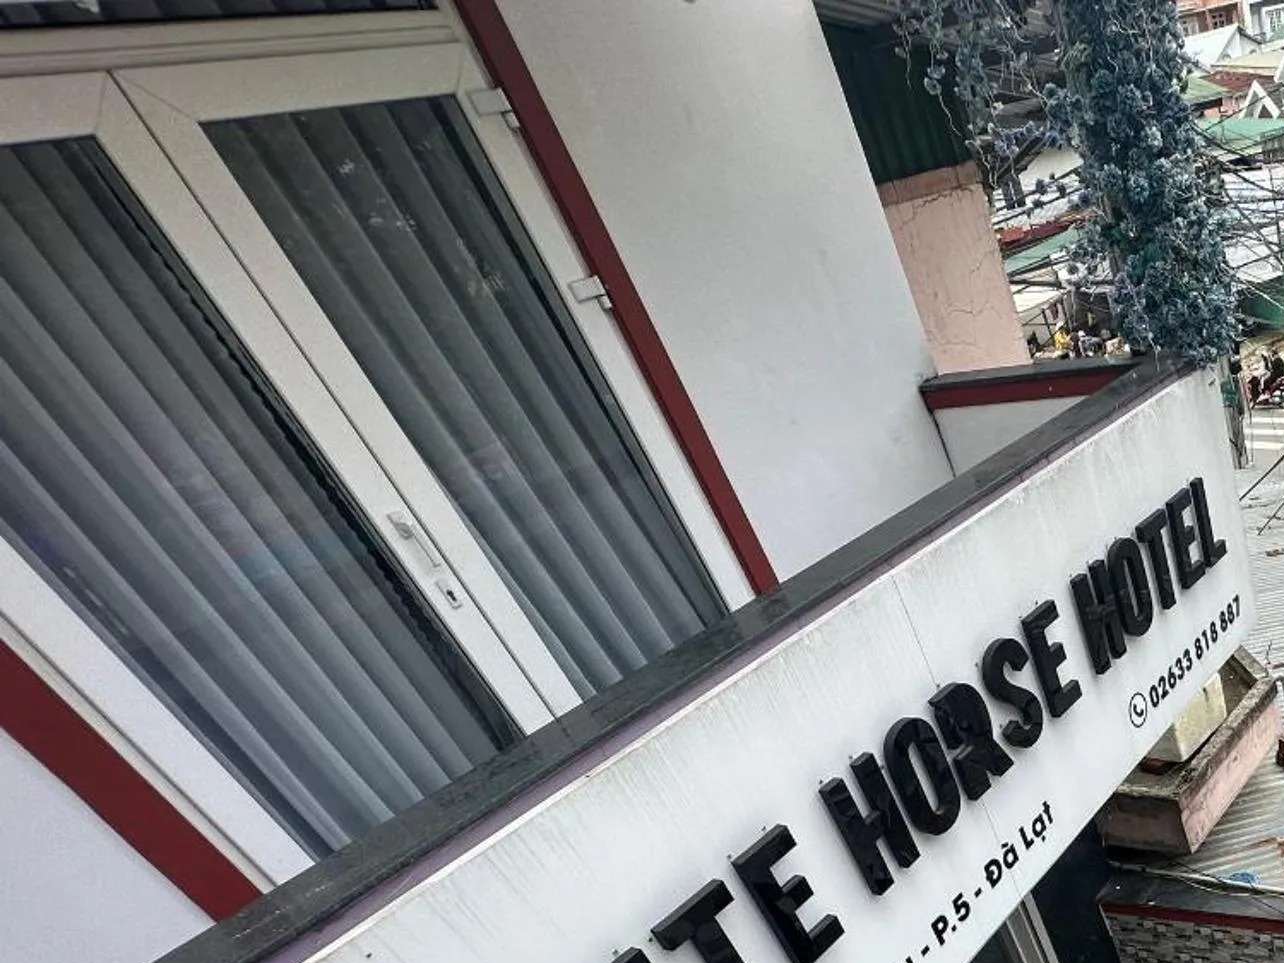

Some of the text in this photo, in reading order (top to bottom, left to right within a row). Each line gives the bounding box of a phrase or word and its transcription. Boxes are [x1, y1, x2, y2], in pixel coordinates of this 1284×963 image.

[819, 599, 1083, 896] HORSE
[1070, 477, 1227, 675] HOTEL
[1149, 594, 1241, 708] 02633 818 887
[931, 892, 971, 946] P.5
[983, 842, 1020, 889] Đà
[1018, 800, 1054, 851] Lạt
